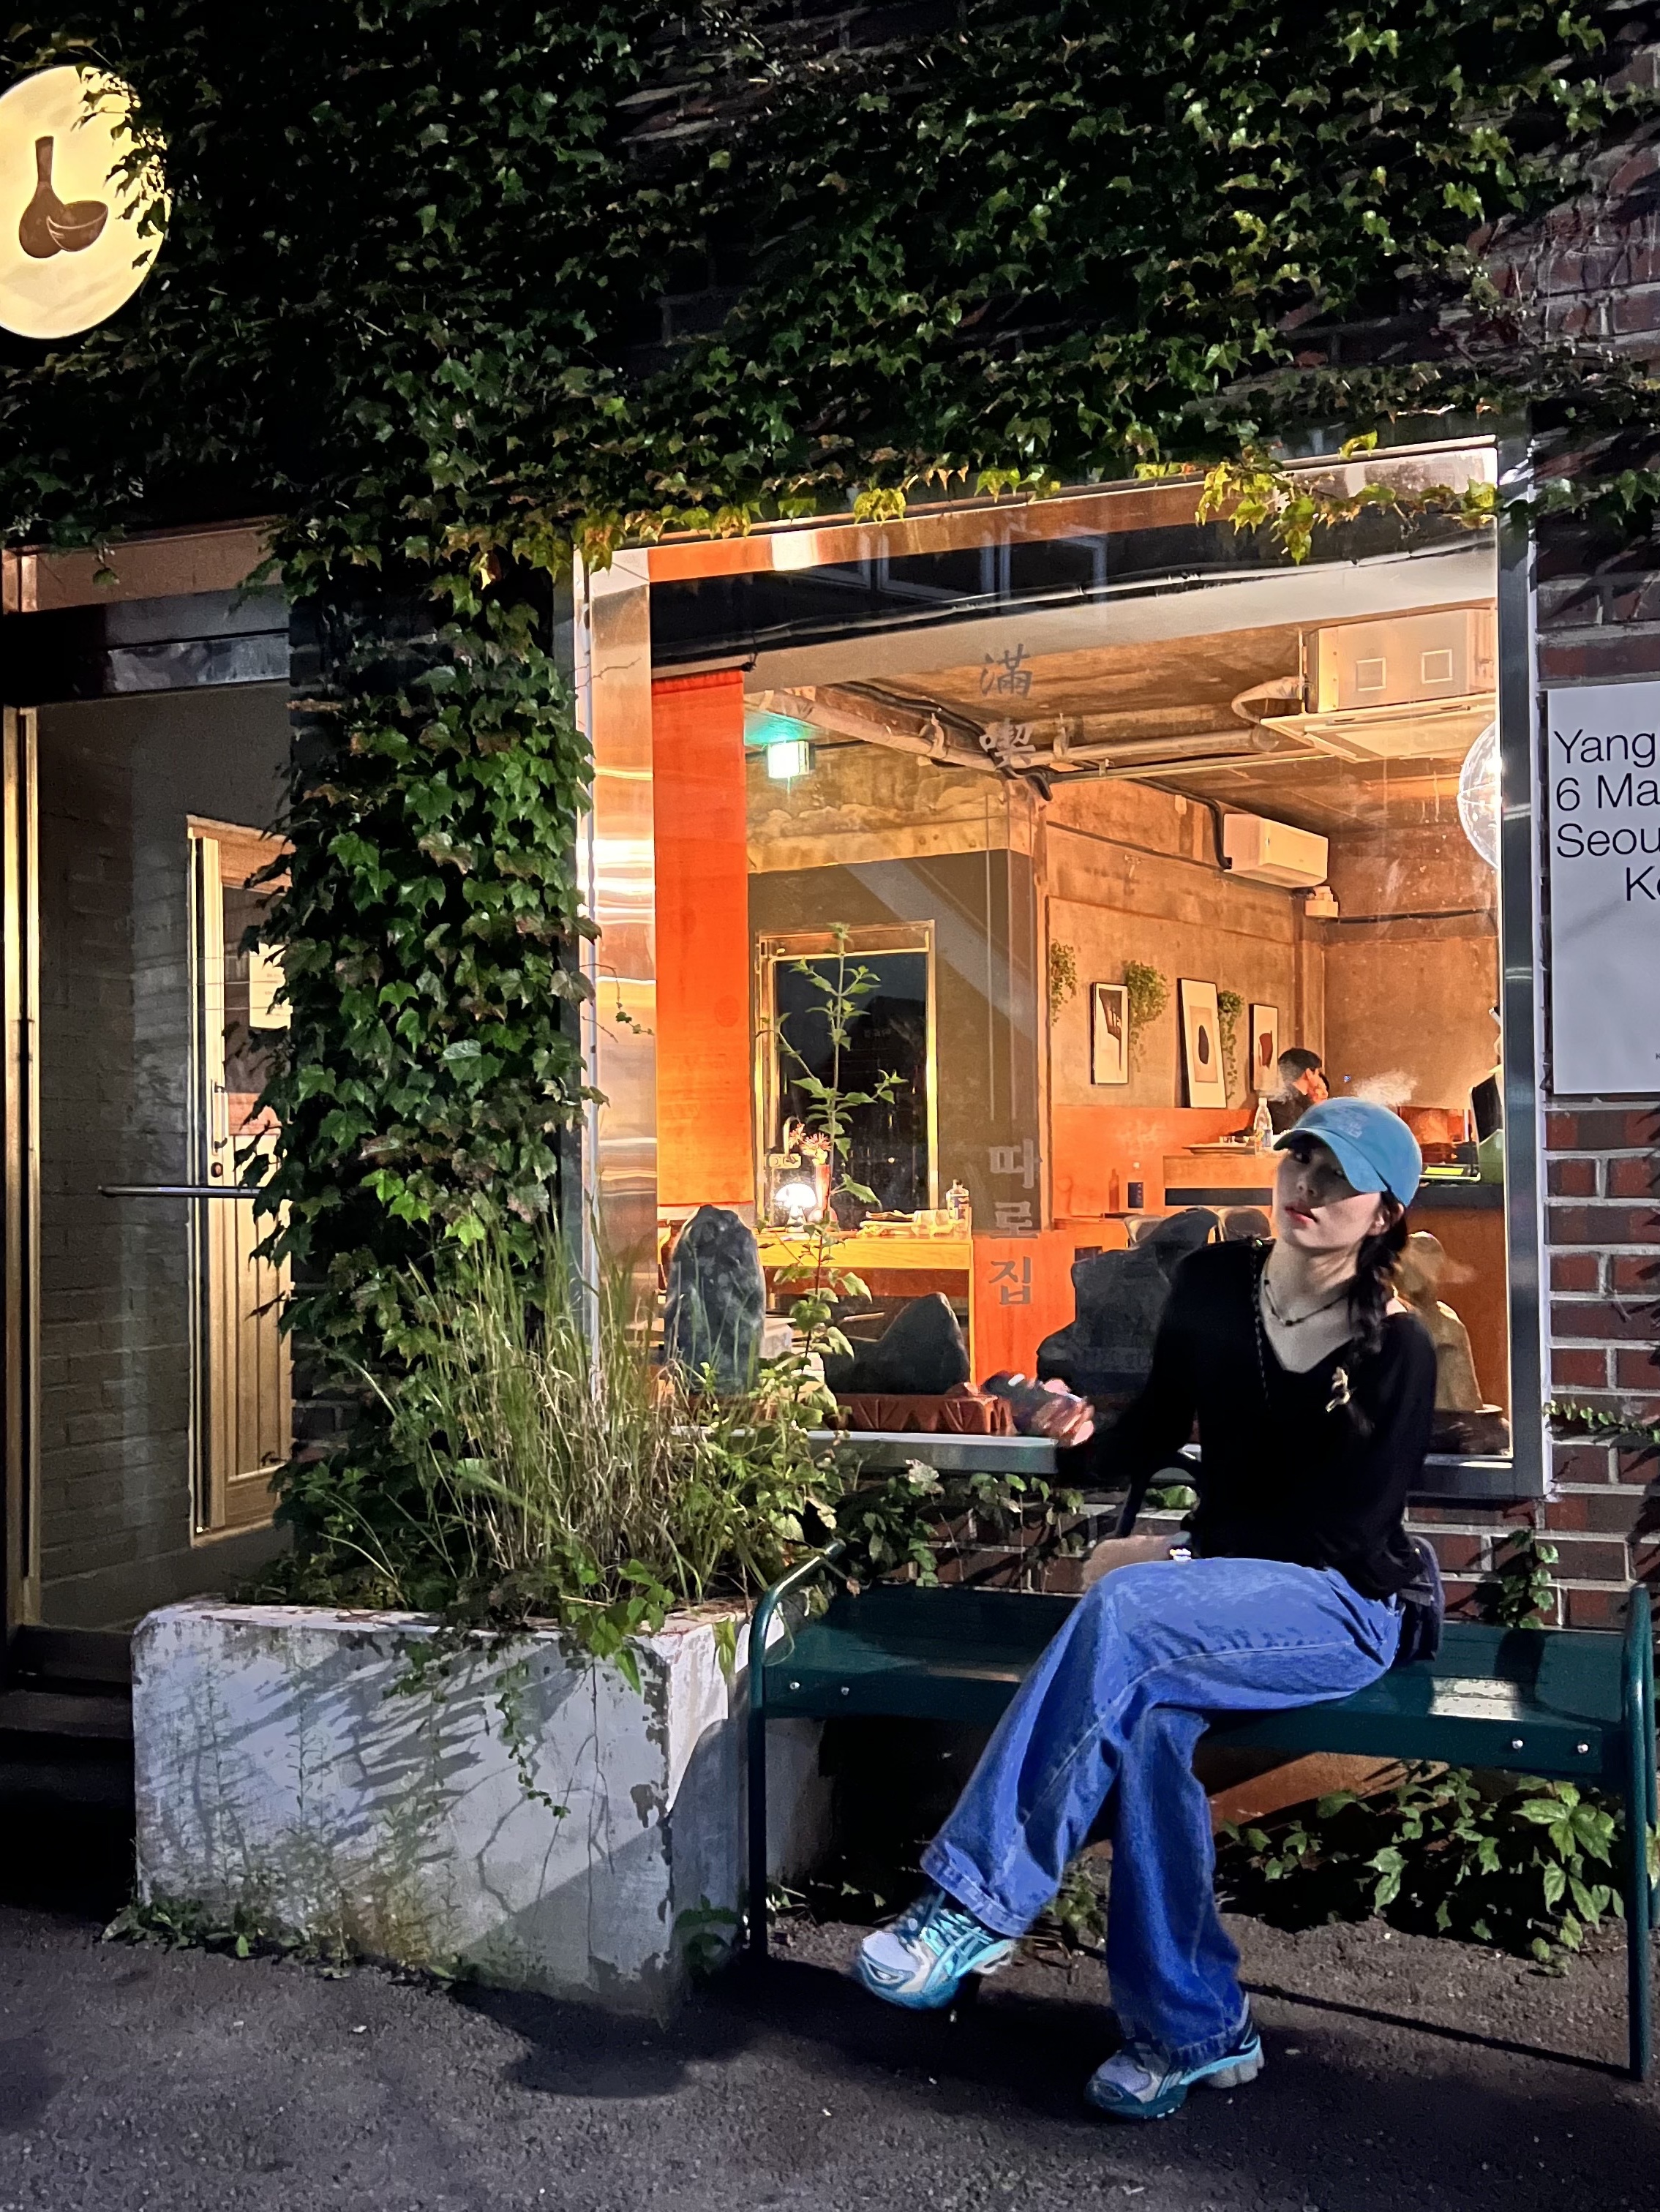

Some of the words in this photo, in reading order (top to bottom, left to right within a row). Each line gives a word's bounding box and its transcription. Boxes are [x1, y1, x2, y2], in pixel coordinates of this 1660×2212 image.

[1553, 729, 1656, 768] Yang
[1556, 777, 1581, 811] 6
[1626, 865, 1660, 901] K
[988, 1138, 1042, 1306] 따로집
